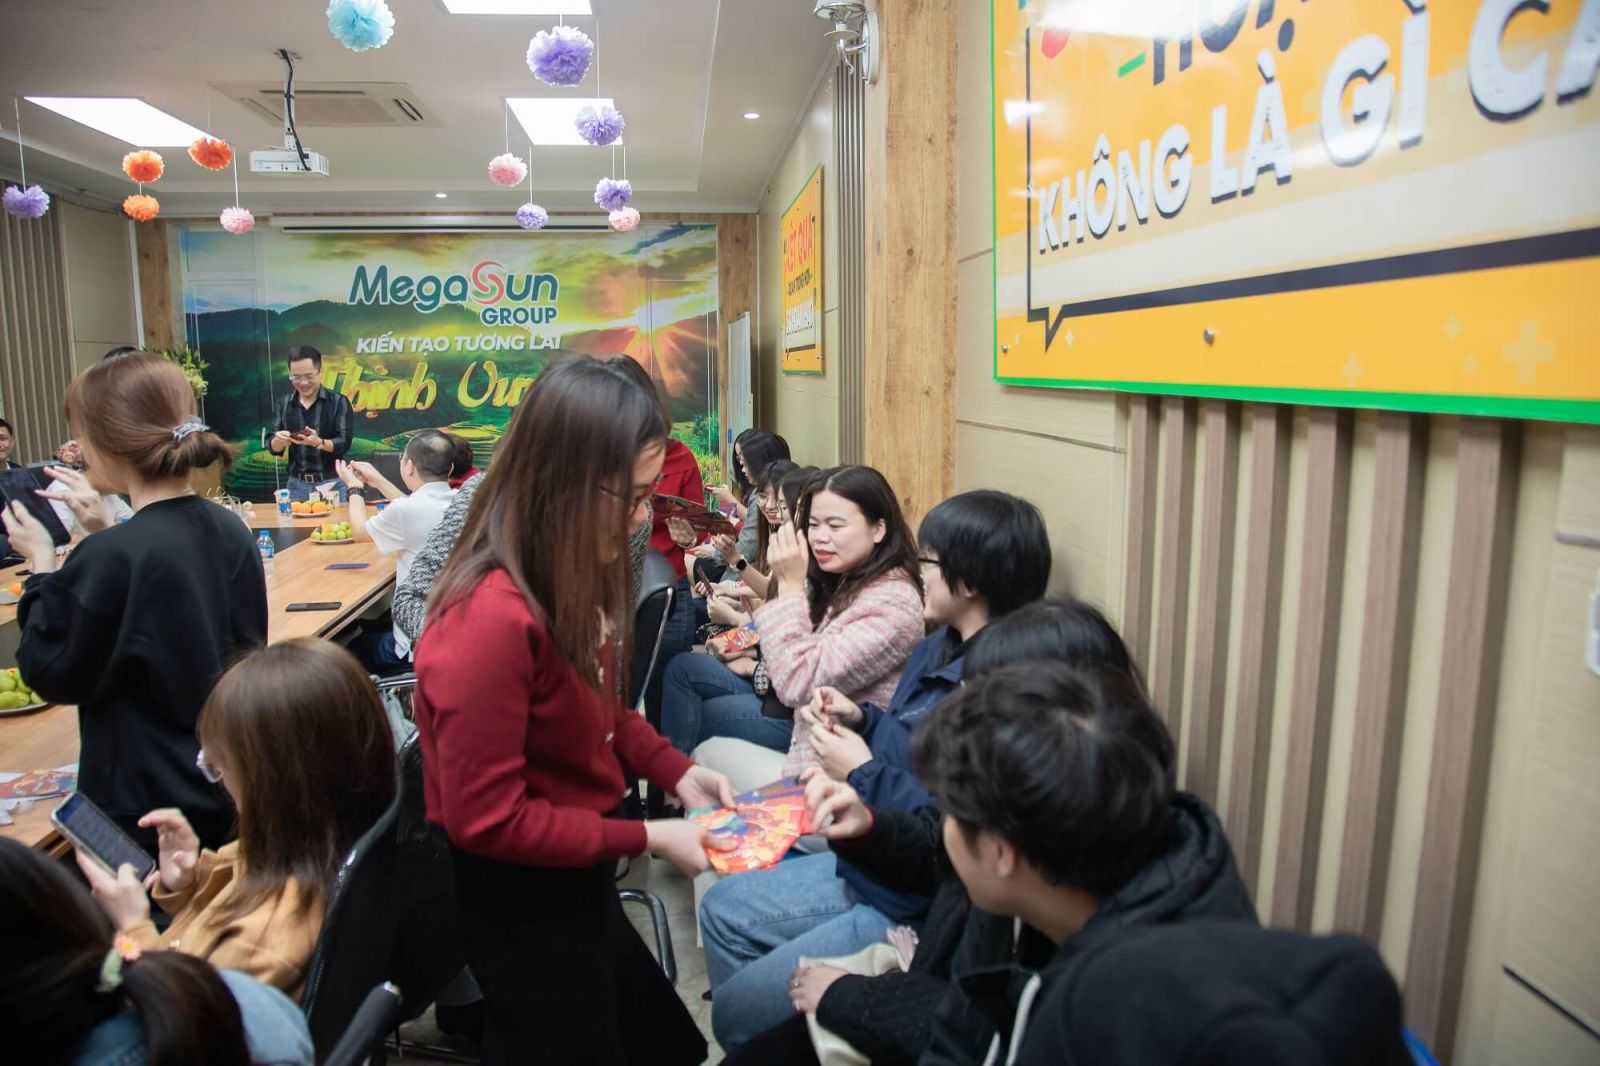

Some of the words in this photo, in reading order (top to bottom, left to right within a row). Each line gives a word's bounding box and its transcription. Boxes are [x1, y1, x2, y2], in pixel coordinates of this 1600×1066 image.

[1038, 124, 1193, 255] KHÔNG
[1211, 47, 1292, 204] LÀ
[1319, 0, 1429, 168] GÌ
[349, 260, 559, 314] MegaSun
[481, 306, 558, 326] GROUP
[356, 331, 404, 354] KIẾN
[409, 336, 450, 356] TẠO
[529, 335, 561, 350] LAI
